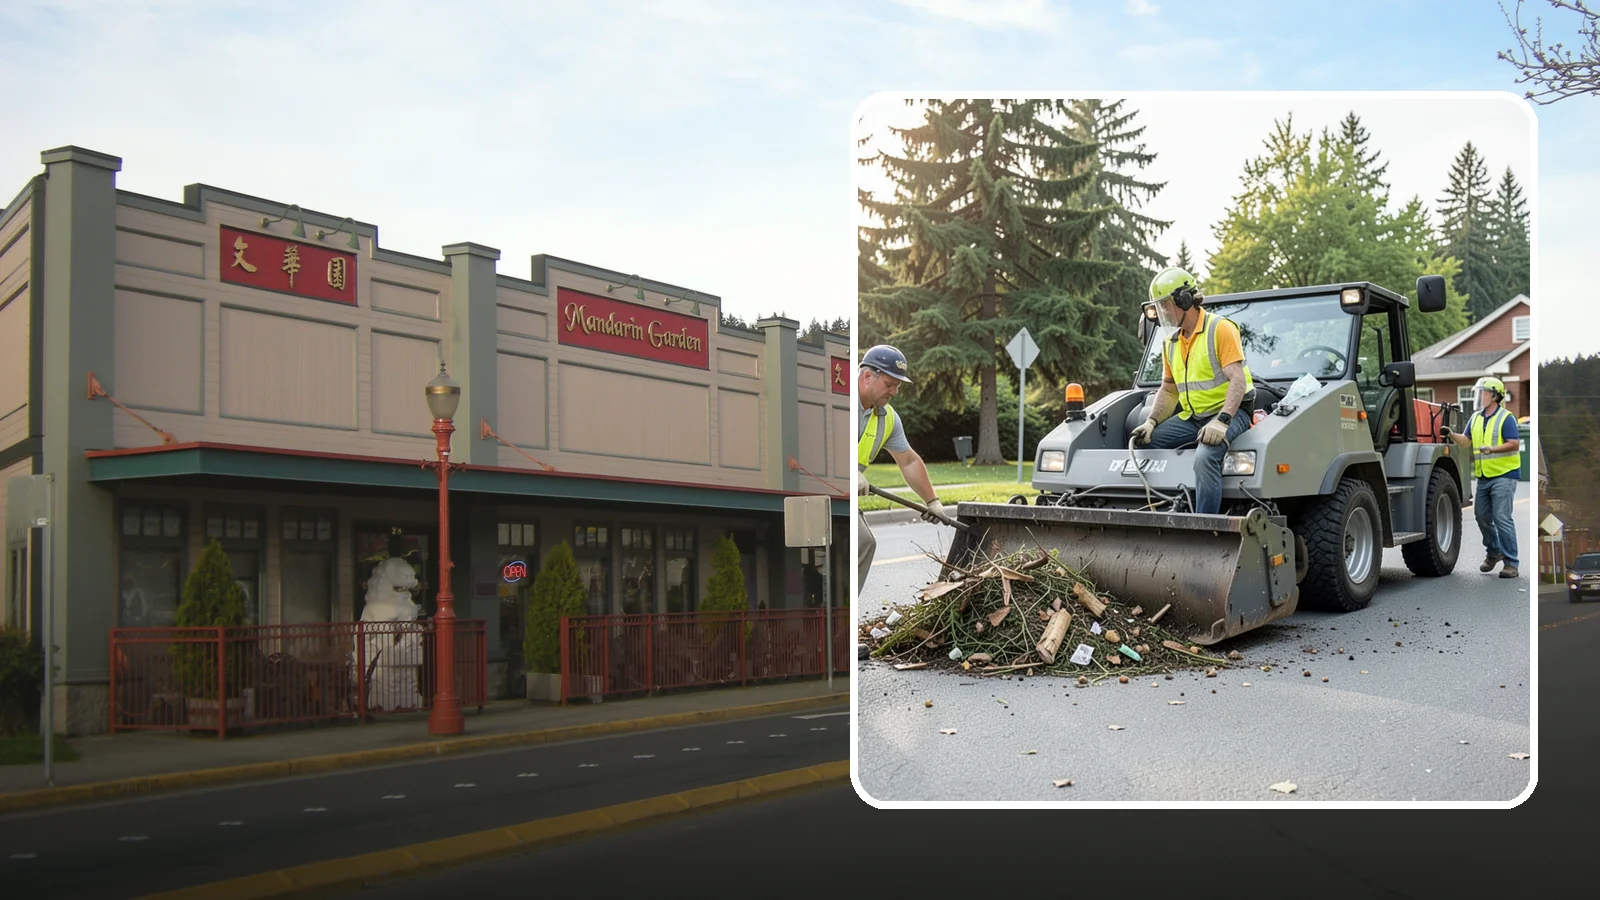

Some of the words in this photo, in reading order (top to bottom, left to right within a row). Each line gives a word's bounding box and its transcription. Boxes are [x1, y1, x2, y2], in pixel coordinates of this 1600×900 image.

[231, 235, 346, 290] 文華園
[564, 302, 644, 341] Mandarin
[647, 320, 702, 352] Garden
[503, 565, 527, 578] OPEN
